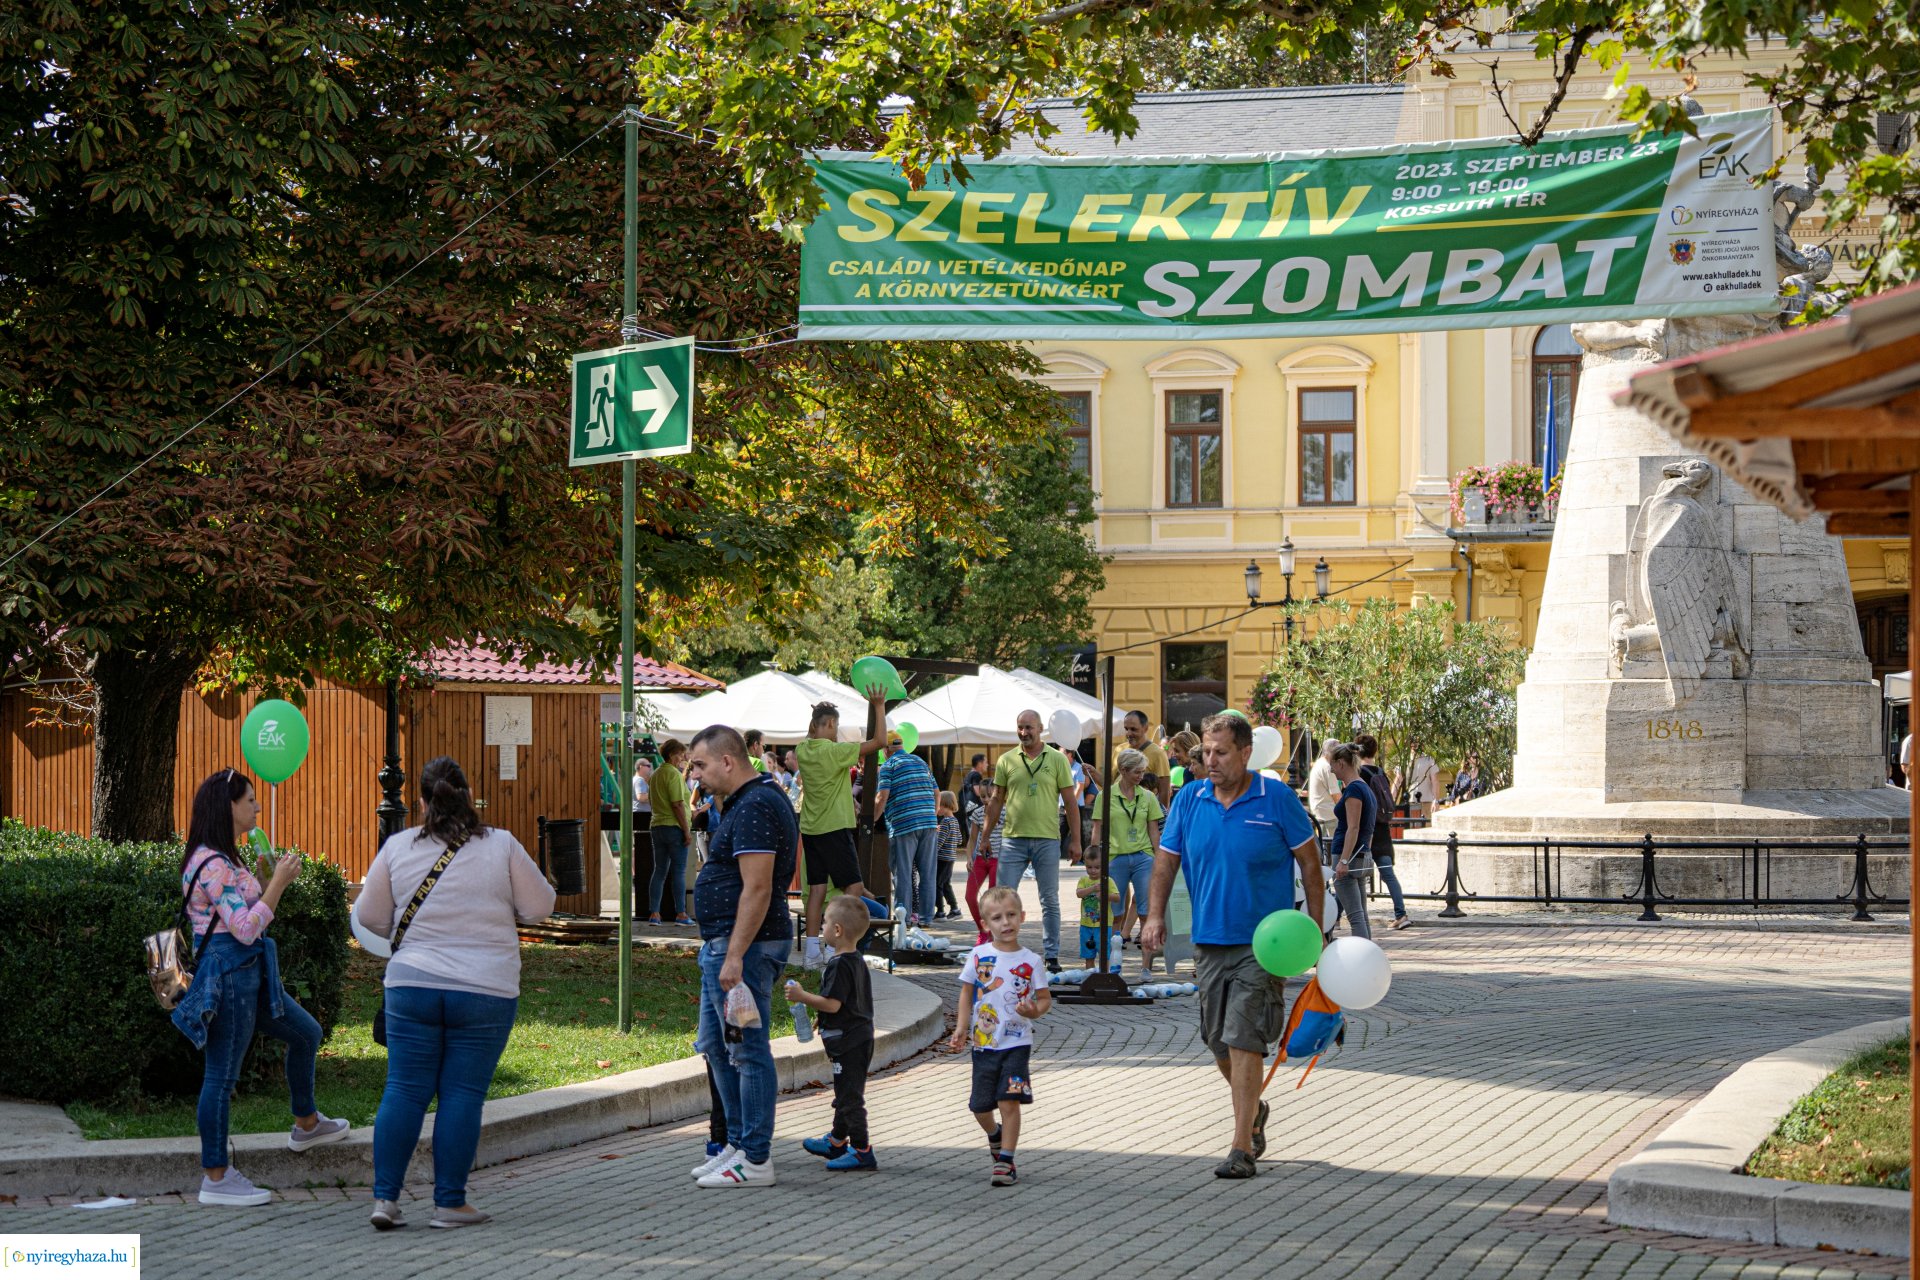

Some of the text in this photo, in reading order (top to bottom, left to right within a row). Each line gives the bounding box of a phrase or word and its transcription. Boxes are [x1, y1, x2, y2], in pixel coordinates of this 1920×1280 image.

[1395, 142, 1664, 181] 2023. SZEPTEMBER 23.
[1391, 184, 1442, 201] 9:00
[1467, 176, 1528, 195] 19:00
[836, 171, 1373, 244] SZELEKTÍV
[1384, 190, 1546, 220] KOSSUTH TÉR
[1696, 207, 1759, 219] NYÍREGYHÁZA
[1702, 254, 1754, 262] ÖNKORMÁNYZATA
[1740, 244, 1760, 252] VÁROS
[827, 257, 1127, 277] CSALÁDI VETÉLKEDŐNAP
[1137, 236, 1636, 318] SZOMBAT
[1682, 269, 1761, 281] www.eakhulladek.hu
[855, 281, 1124, 298] A KÖRNYEZETÜNKÉRT
[1716, 281, 1761, 291] eakhulladek
[1644, 719, 1703, 739] 1848
[433, 848, 455, 872] FILA
[415, 877, 437, 900] FILA
[402, 902, 419, 924] FILA
